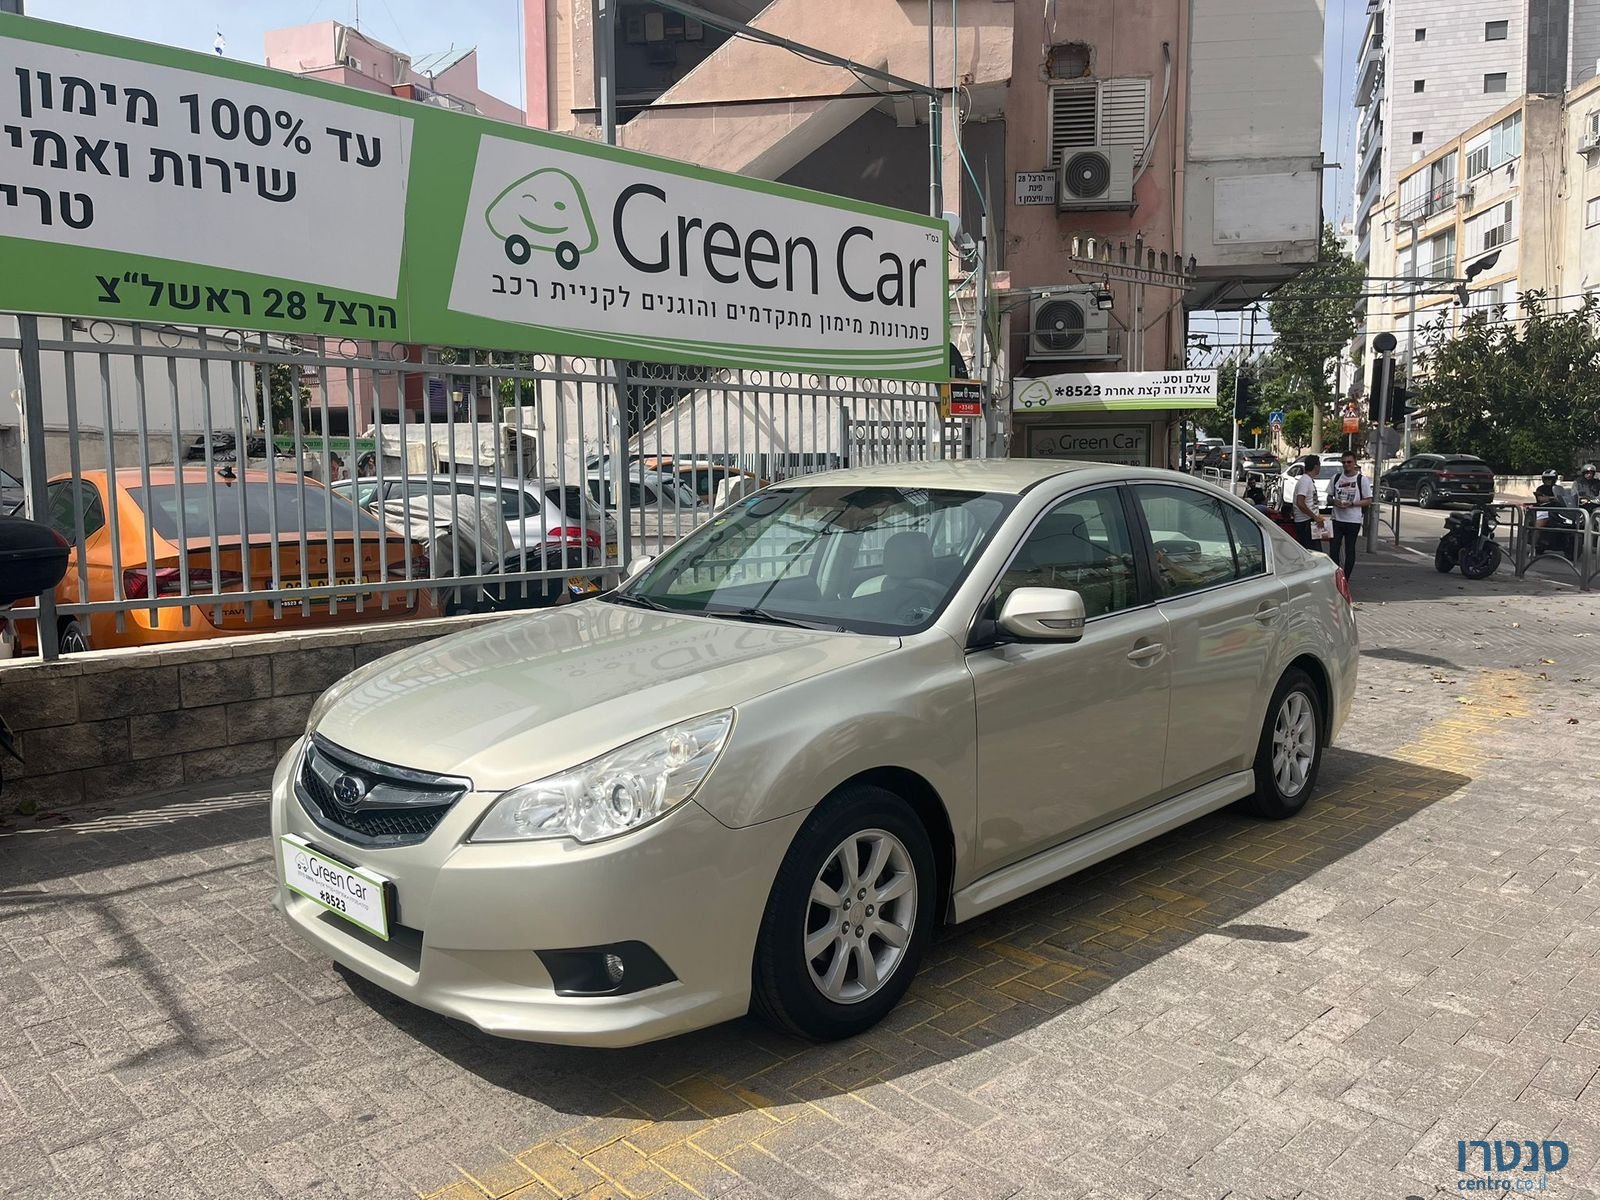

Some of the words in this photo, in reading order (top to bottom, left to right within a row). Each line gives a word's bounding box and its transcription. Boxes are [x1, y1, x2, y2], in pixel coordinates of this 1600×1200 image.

[15, 67, 159, 128] מימון
[180, 94, 312, 155] 100%
[326, 128, 381, 168] עד
[149, 148, 297, 203] שירות
[1027, 173, 1046, 182] הרצל
[1028, 184, 1043, 192] פינת
[613, 184, 818, 294] Green
[837, 226, 927, 309] Car
[492, 274, 539, 298] רכב
[550, 281, 630, 311] לקניית
[263, 289, 307, 321] 28
[317, 292, 397, 329] הרצל
[642, 292, 716, 318] והוגנים
[727, 303, 812, 330] מתקדמים
[819, 314, 863, 335] מימון
[870, 320, 929, 341] פתרונות
[1105, 387, 1135, 396] אחרת
[1164, 386, 1176, 395] זה
[1180, 384, 1211, 394] אצלנו
[1186, 374, 1211, 384] שלם
[1138, 387, 1161, 398] קצת
[1059, 433, 1108, 451] Green
[1112, 433, 1142, 449] Car
[310, 857, 345, 890] Green
[347, 875, 367, 900] Car
